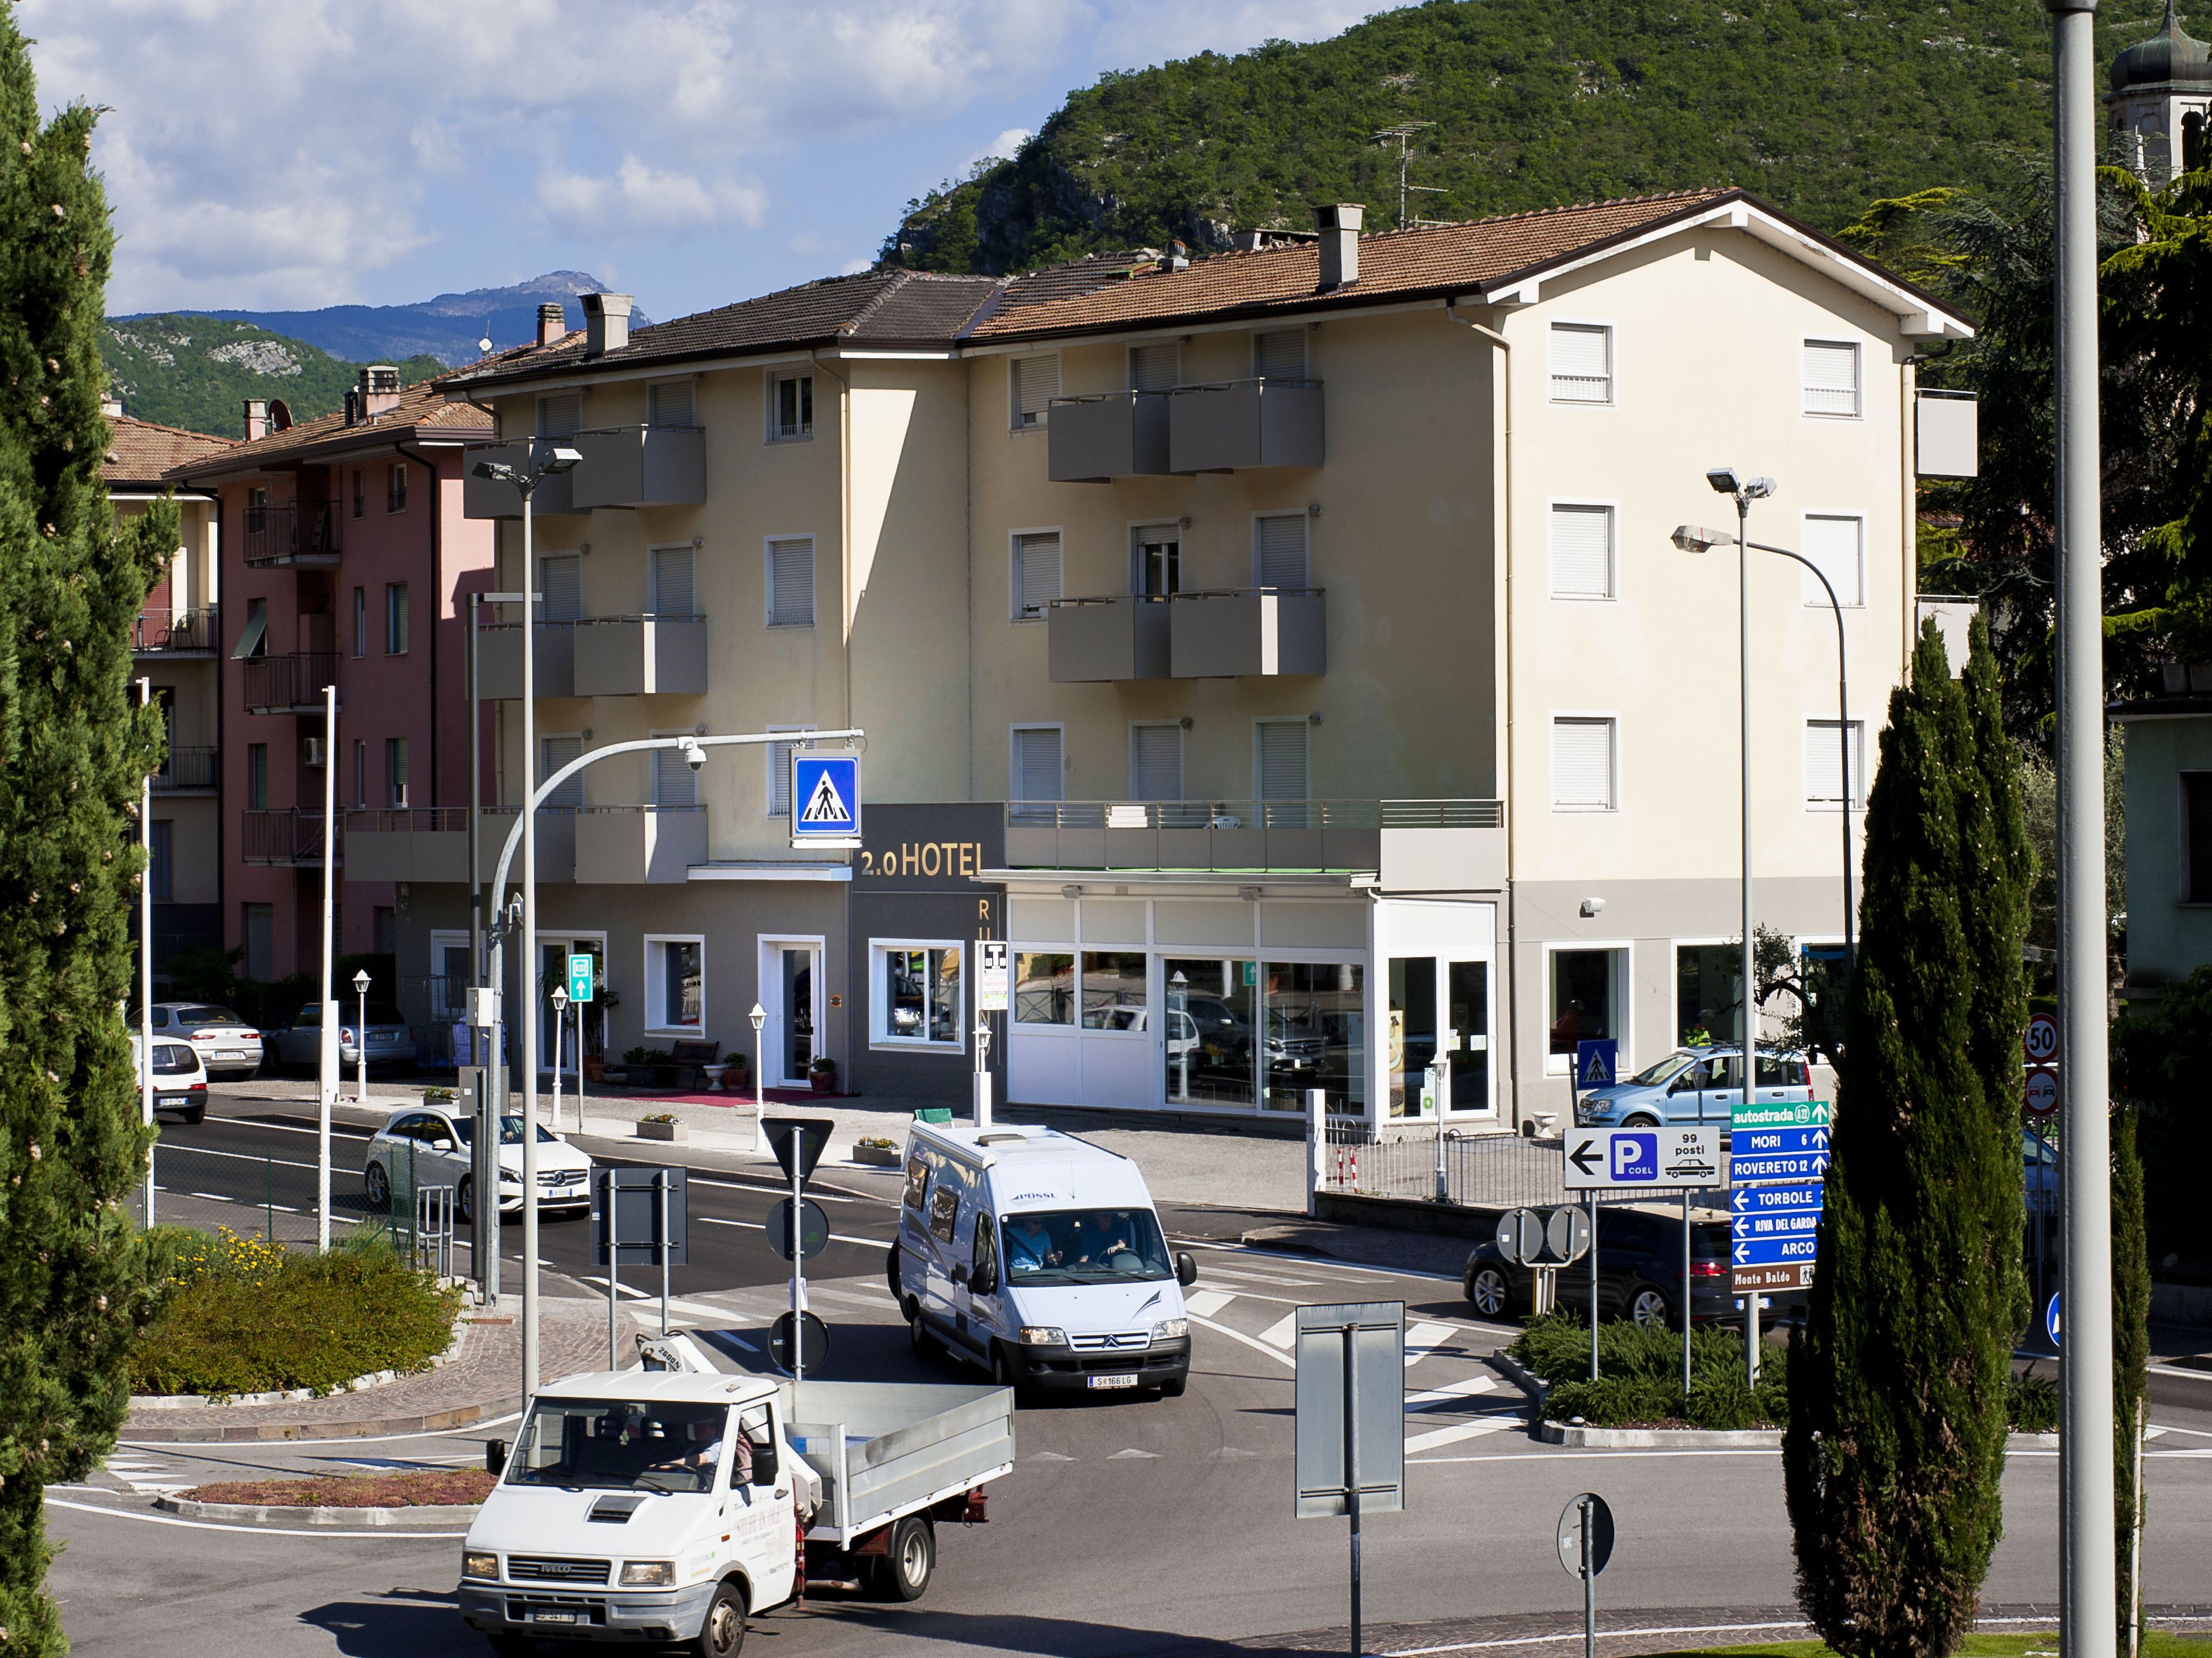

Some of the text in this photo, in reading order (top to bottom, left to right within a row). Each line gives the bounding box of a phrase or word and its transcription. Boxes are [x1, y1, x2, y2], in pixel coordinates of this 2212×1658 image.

[861, 851, 897, 876] 2.0
[2029, 1027, 2054, 1051] 50
[1733, 1108, 1794, 1124] autostrada
[1682, 1134, 1698, 1143] 99
[1751, 1134, 1808, 1149] MORI 6
[1615, 1140, 1642, 1174] P
[1675, 1145, 1705, 1156] posti
[1734, 1159, 1808, 1175] ROVERETO 12
[1758, 1191, 1813, 1205] TORBOLE
[1755, 1219, 1773, 1232] RIVA
[1775, 1217, 1789, 1231] DEL
[1781, 1241, 1815, 1255] ARCO
[1734, 1270, 1790, 1286] Monte Baldo
[541, 1565, 571, 1573] IVECO
